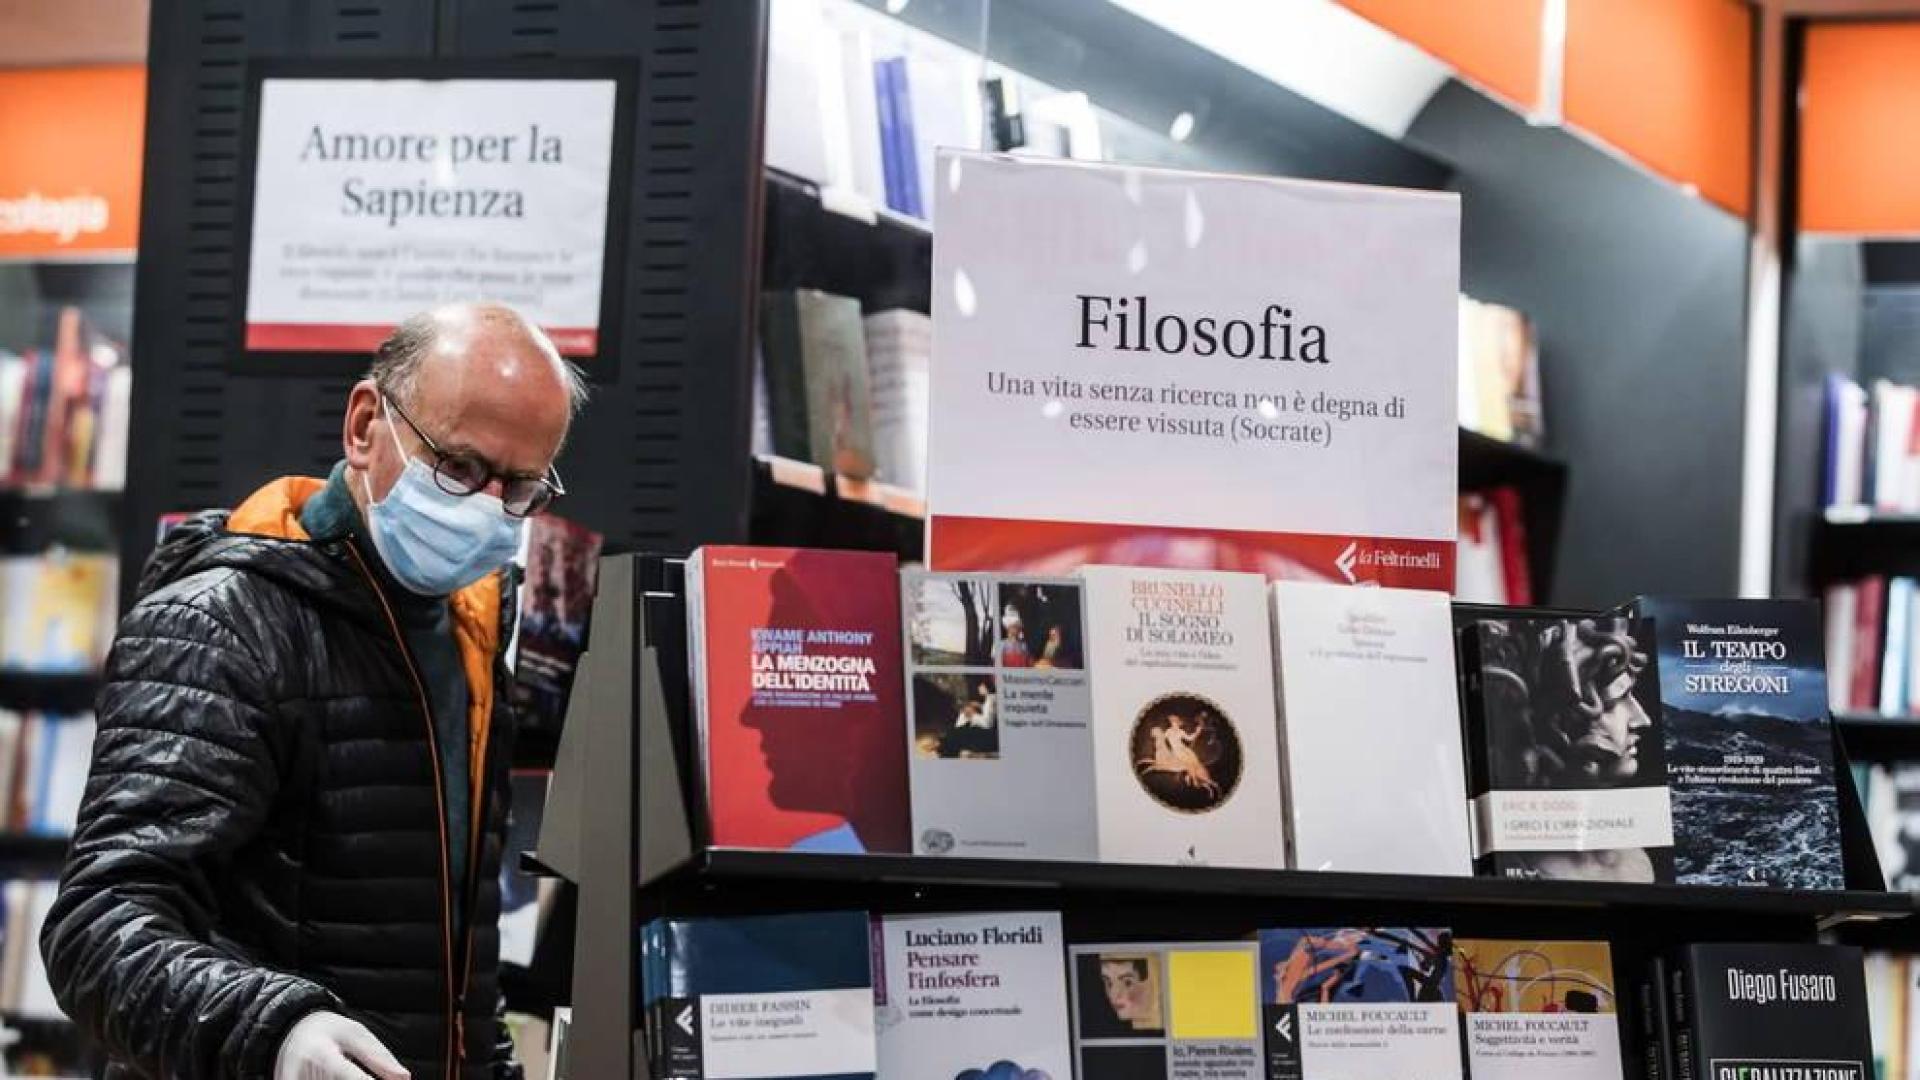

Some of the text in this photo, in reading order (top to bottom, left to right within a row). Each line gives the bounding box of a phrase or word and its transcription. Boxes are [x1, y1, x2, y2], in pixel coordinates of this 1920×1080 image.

[300, 124, 563, 172] Amore per la
[342, 177, 525, 227] Sapienza
[1075, 294, 1330, 364] Filosofia
[987, 371, 1035, 396] Una
[1041, 375, 1083, 399] vita
[1089, 383, 1153, 403] senza
[1160, 381, 1237, 408] ricerca
[1293, 389, 1306, 412] è
[1311, 391, 1378, 422] degna
[1384, 396, 1405, 419] di
[1069, 411, 1331, 448] essere vissuta (Socrate)
[1132, 580, 1224, 597] BRUNELLO
[1130, 597, 1223, 615] CUCINELLI
[1139, 612, 1221, 629] IL SOGNO
[806, 630, 874, 645] ANTHONY
[1126, 627, 1234, 647] DI SOLOMEO
[1683, 639, 1787, 660] IL TEMPO
[752, 654, 877, 675] LA MENZOGNA
[1719, 660, 1751, 675] degli
[1003, 687, 1017, 699] La
[1685, 674, 1790, 694] STREGONI
[1543, 799, 1579, 811] DODD
[1553, 816, 1634, 831] L'IRRZIONALE
[905, 925, 1043, 947] Luciano Floridi
[906, 950, 979, 969] Pensare
[907, 970, 1001, 990] l'infosfera
[1727, 967, 1836, 1004] Diego Fusaro
[709, 1000, 811, 1015] DIDIER FASSIN
[1306, 1009, 1429, 1022] MICHEL FOUCAULT
[1474, 1019, 1589, 1032] MICHEL FOUCAULT
